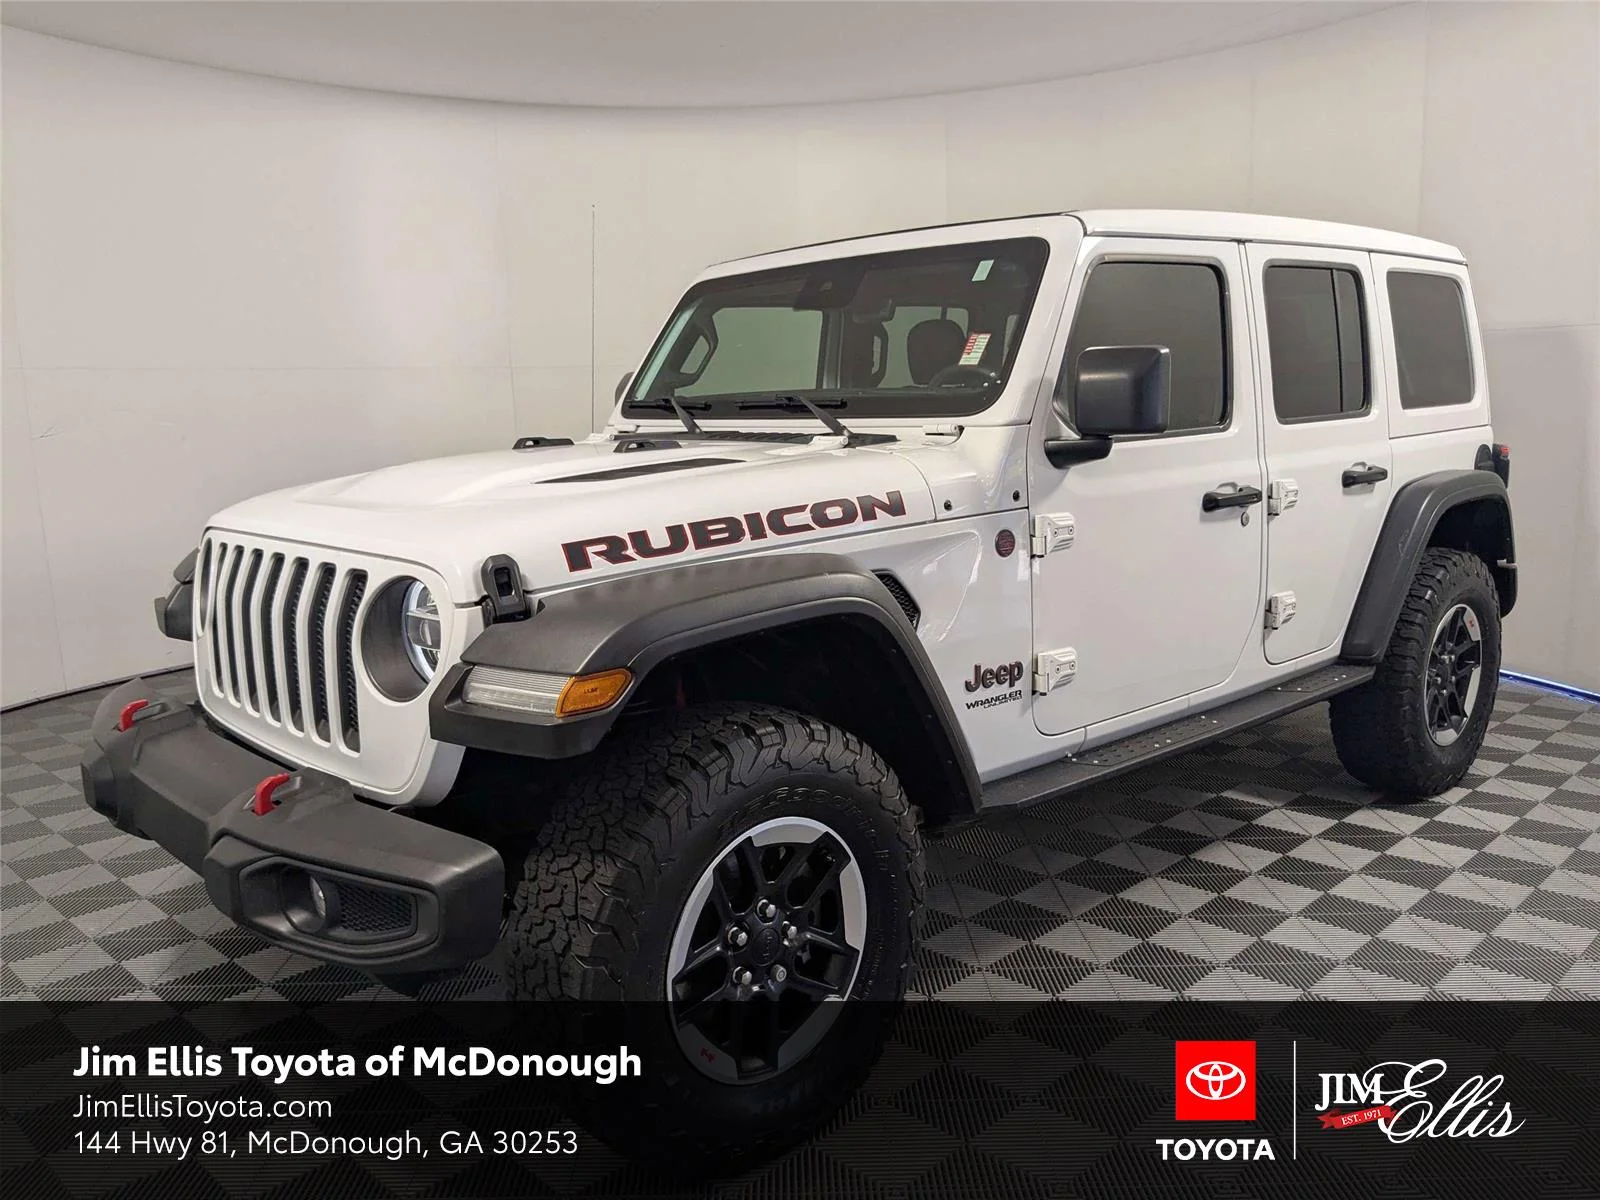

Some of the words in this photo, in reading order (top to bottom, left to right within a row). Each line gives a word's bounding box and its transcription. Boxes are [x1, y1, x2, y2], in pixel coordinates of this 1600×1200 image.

[561, 490, 907, 573] RUBICON
[964, 660, 1024, 693] Jeep
[965, 689, 1022, 710] WRANGLER
